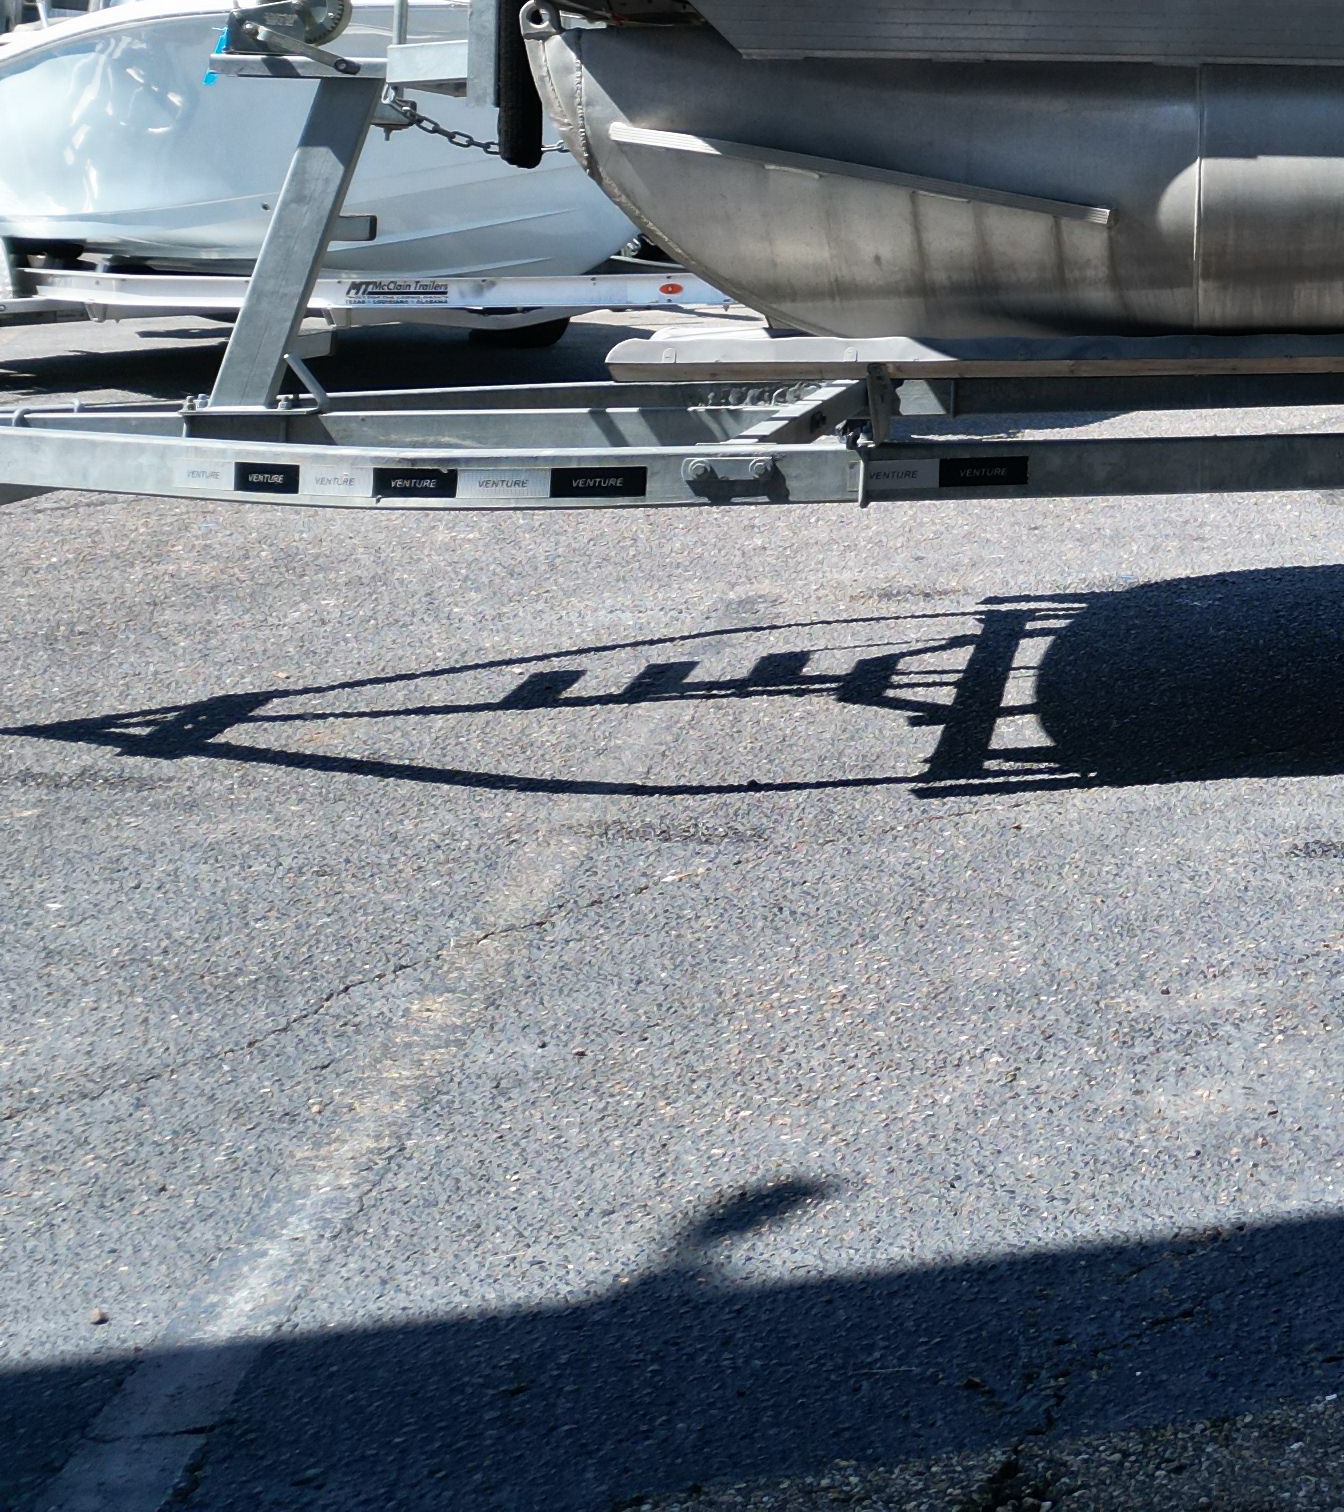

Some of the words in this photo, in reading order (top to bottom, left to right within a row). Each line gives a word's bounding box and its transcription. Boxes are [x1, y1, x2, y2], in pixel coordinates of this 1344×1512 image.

[373, 280, 412, 291] McClain
[413, 280, 449, 291] Trailers
[869, 470, 918, 480] VENTURE
[960, 467, 1008, 477] VENTURE
[248, 474, 284, 484] VENTURE
[315, 476, 355, 486] VENTURE
[391, 478, 437, 488] VENTURE
[478, 479, 529, 488] VENTURE
[572, 477, 624, 487] VENTURE
